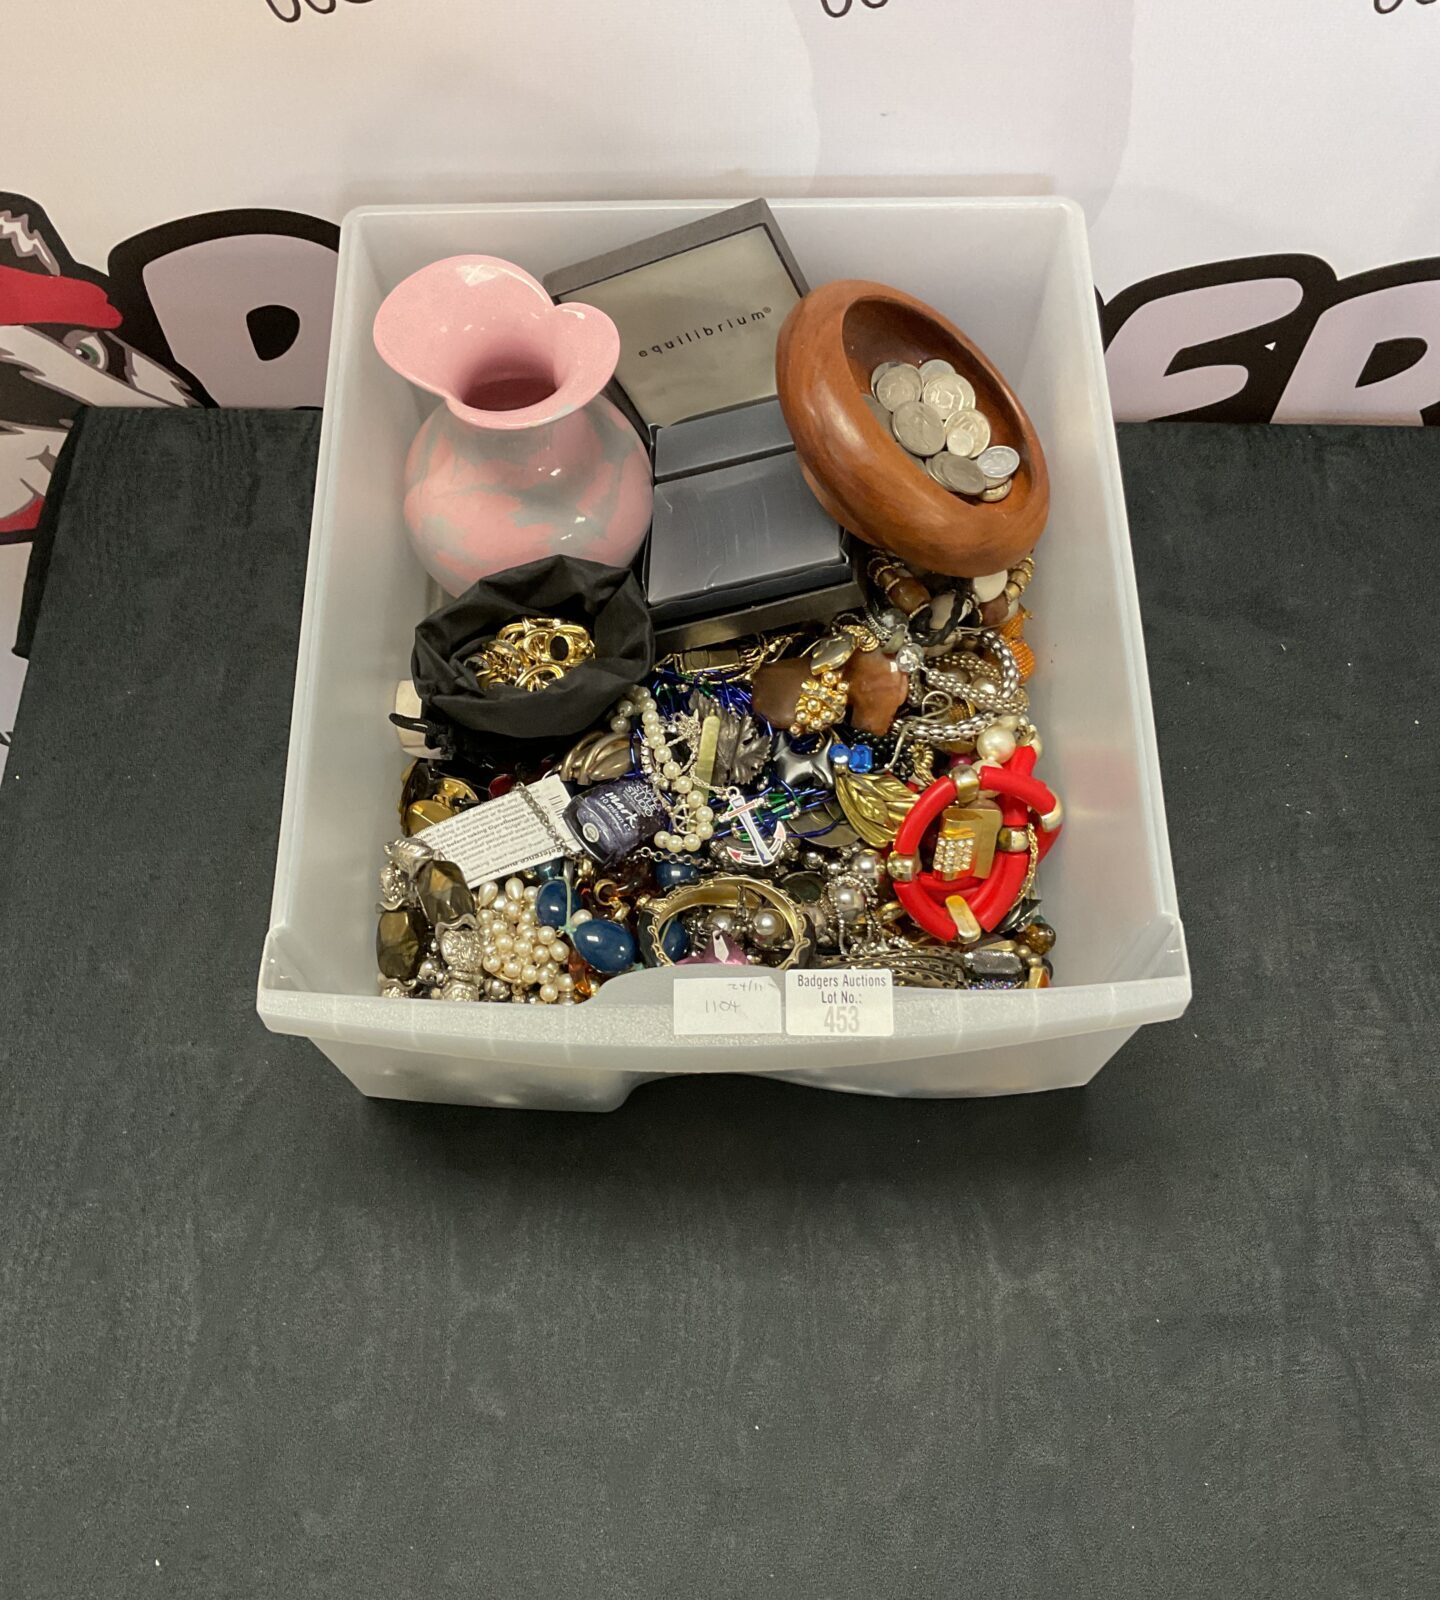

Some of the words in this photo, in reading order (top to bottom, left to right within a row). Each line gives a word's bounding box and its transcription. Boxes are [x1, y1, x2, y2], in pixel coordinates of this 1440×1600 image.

[624, 786, 653, 817] STUDIO
[633, 785, 657, 811] STYLE
[797, 974, 839, 990] Badgers
[842, 973, 887, 987] Auctions
[705, 999, 741, 1013] 1104
[821, 990, 838, 1004] Lot
[841, 990, 862, 1004] No.:
[823, 1005, 860, 1033] 453
